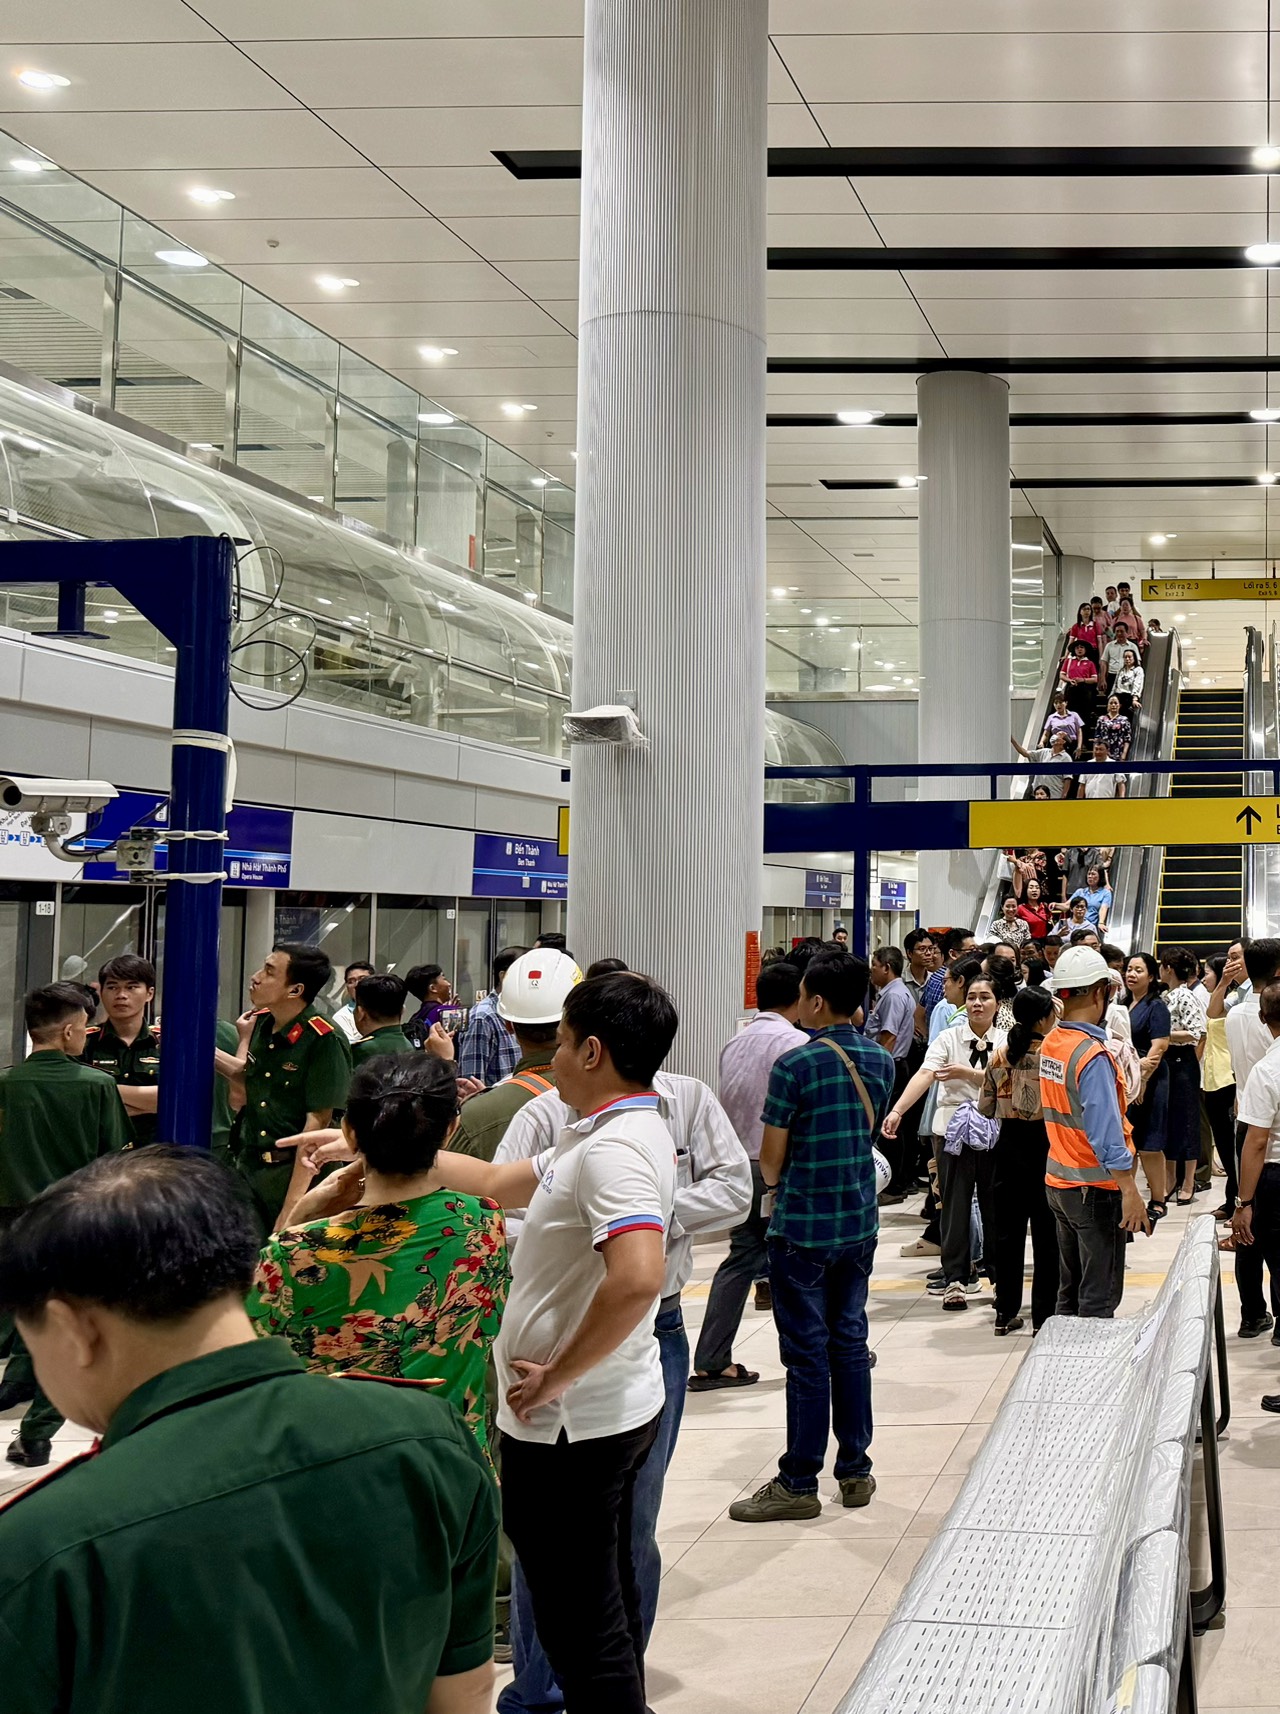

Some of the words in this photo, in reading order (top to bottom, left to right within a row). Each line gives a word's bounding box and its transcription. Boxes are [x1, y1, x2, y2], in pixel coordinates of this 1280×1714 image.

[1195, 582, 1199, 590] 3
[514, 842, 524, 855] Bến
[525, 844, 540, 856] Thành
[1042, 1059, 1061, 1073] HITACHI
